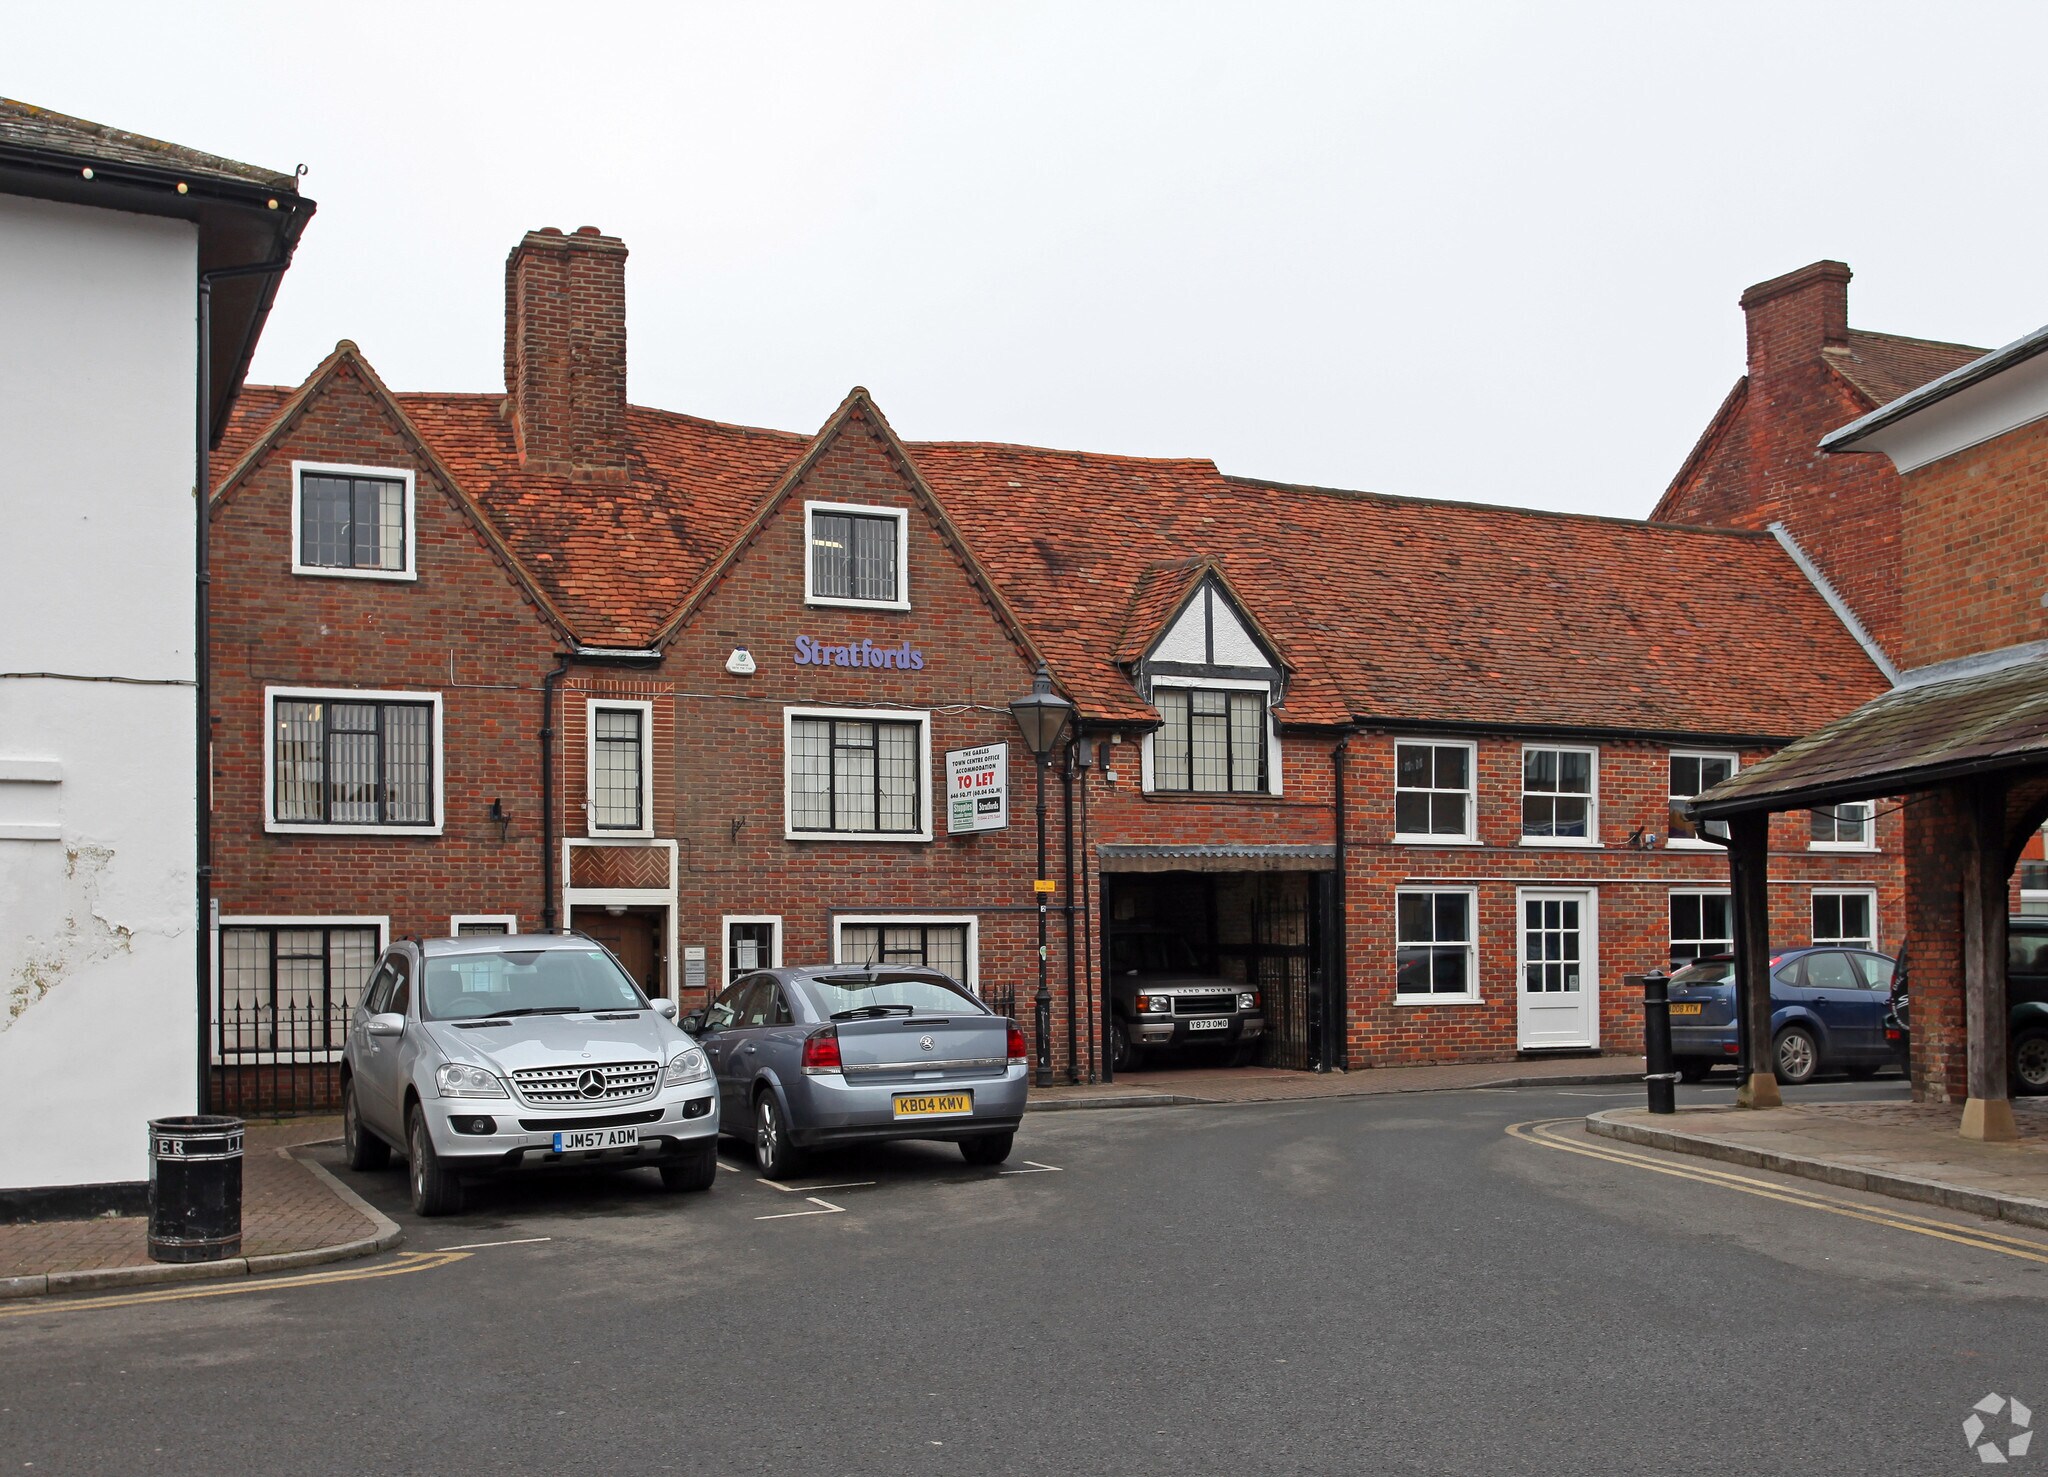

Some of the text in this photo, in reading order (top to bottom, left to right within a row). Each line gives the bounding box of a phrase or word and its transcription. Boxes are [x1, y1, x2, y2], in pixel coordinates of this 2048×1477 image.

[793, 635, 924, 670] Stratfords
[972, 748, 989, 756] GABLES
[952, 759, 966, 767] TOWN
[984, 754, 1000, 762] OFFICE
[956, 763, 996, 774] ACCOMMODATION
[958, 771, 995, 789] TO LET
[979, 801, 999, 811] Stratfords
[1191, 1021, 1211, 1029] Y873
[900, 1097, 964, 1113] KB04 KMV
[565, 1129, 637, 1149] JM57 ADM
